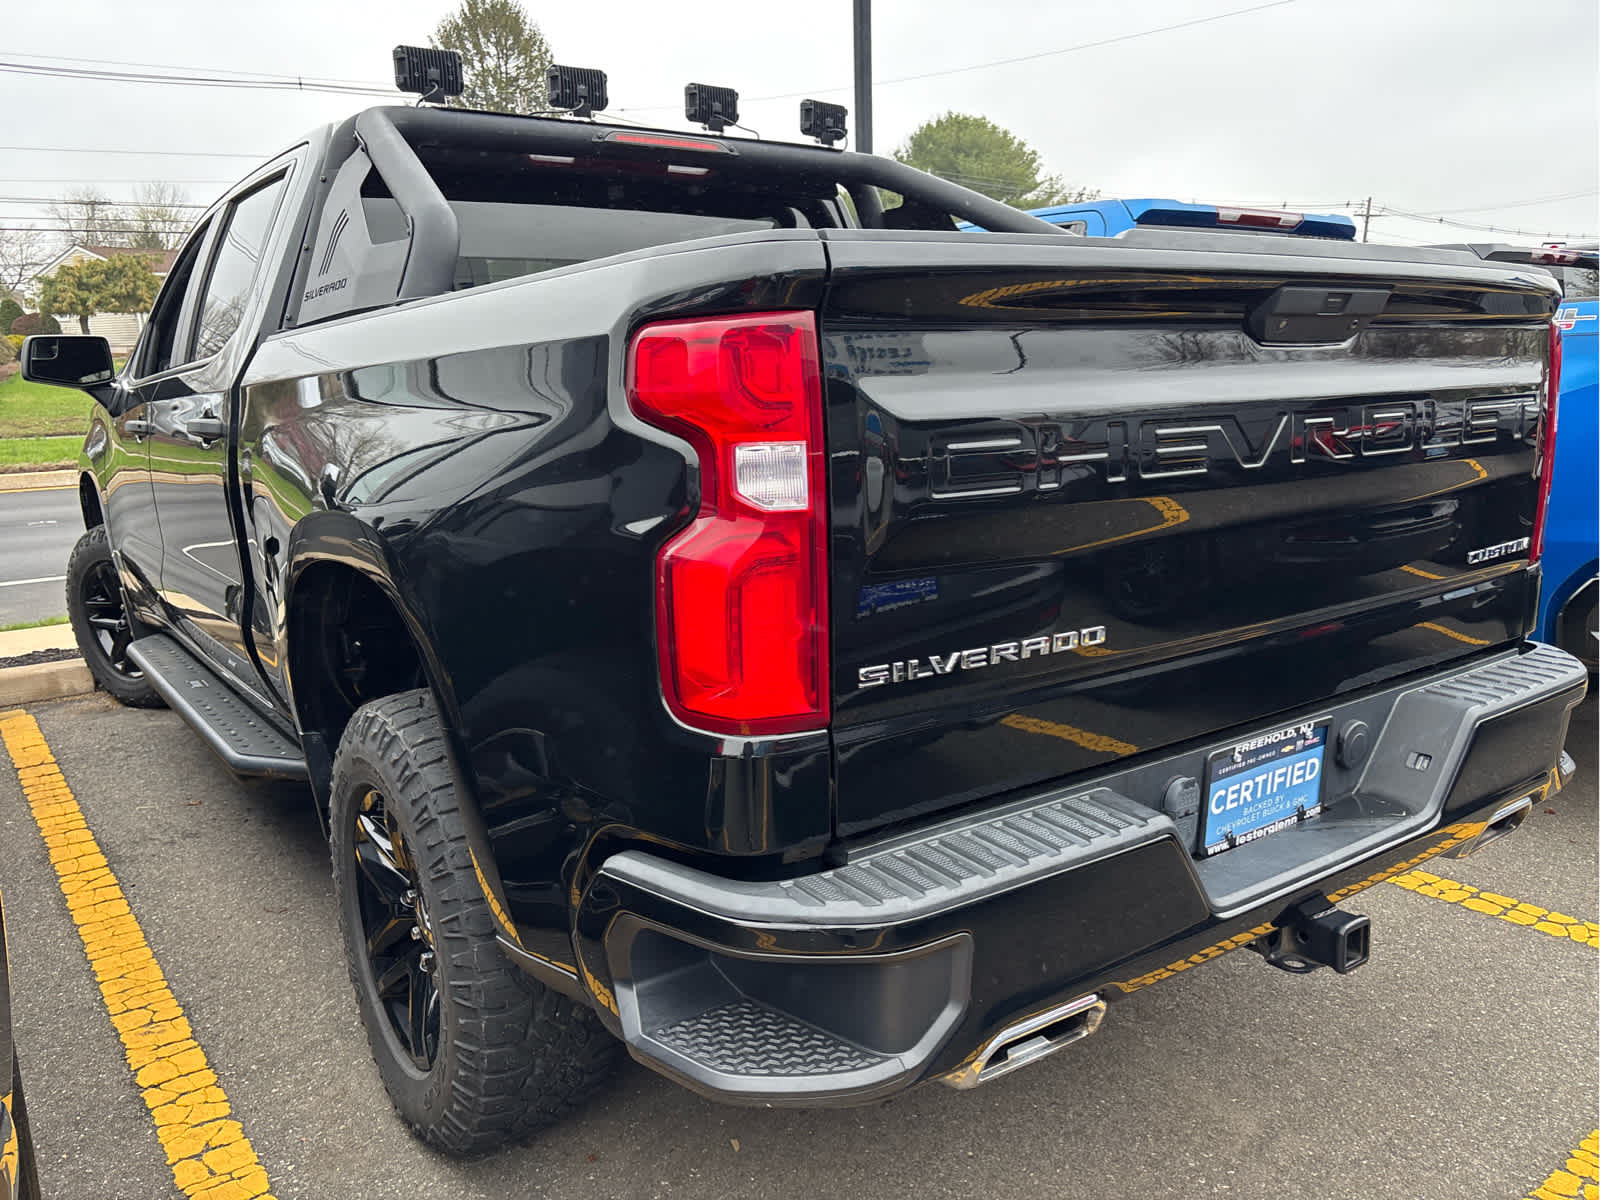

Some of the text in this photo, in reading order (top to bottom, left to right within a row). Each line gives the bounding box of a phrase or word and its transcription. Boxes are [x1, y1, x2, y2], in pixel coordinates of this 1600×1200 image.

[304, 278, 347, 301] SILVERADO
[929, 396, 1539, 499] CHEVROLET
[858, 625, 1106, 689] SILVERADO
[1211, 757, 1320, 815] CERTIFIED
[1243, 795, 1284, 816] BACKED BY
[1216, 812, 1260, 835] CHEVROLET
[1262, 803, 1284, 817] BUICK
